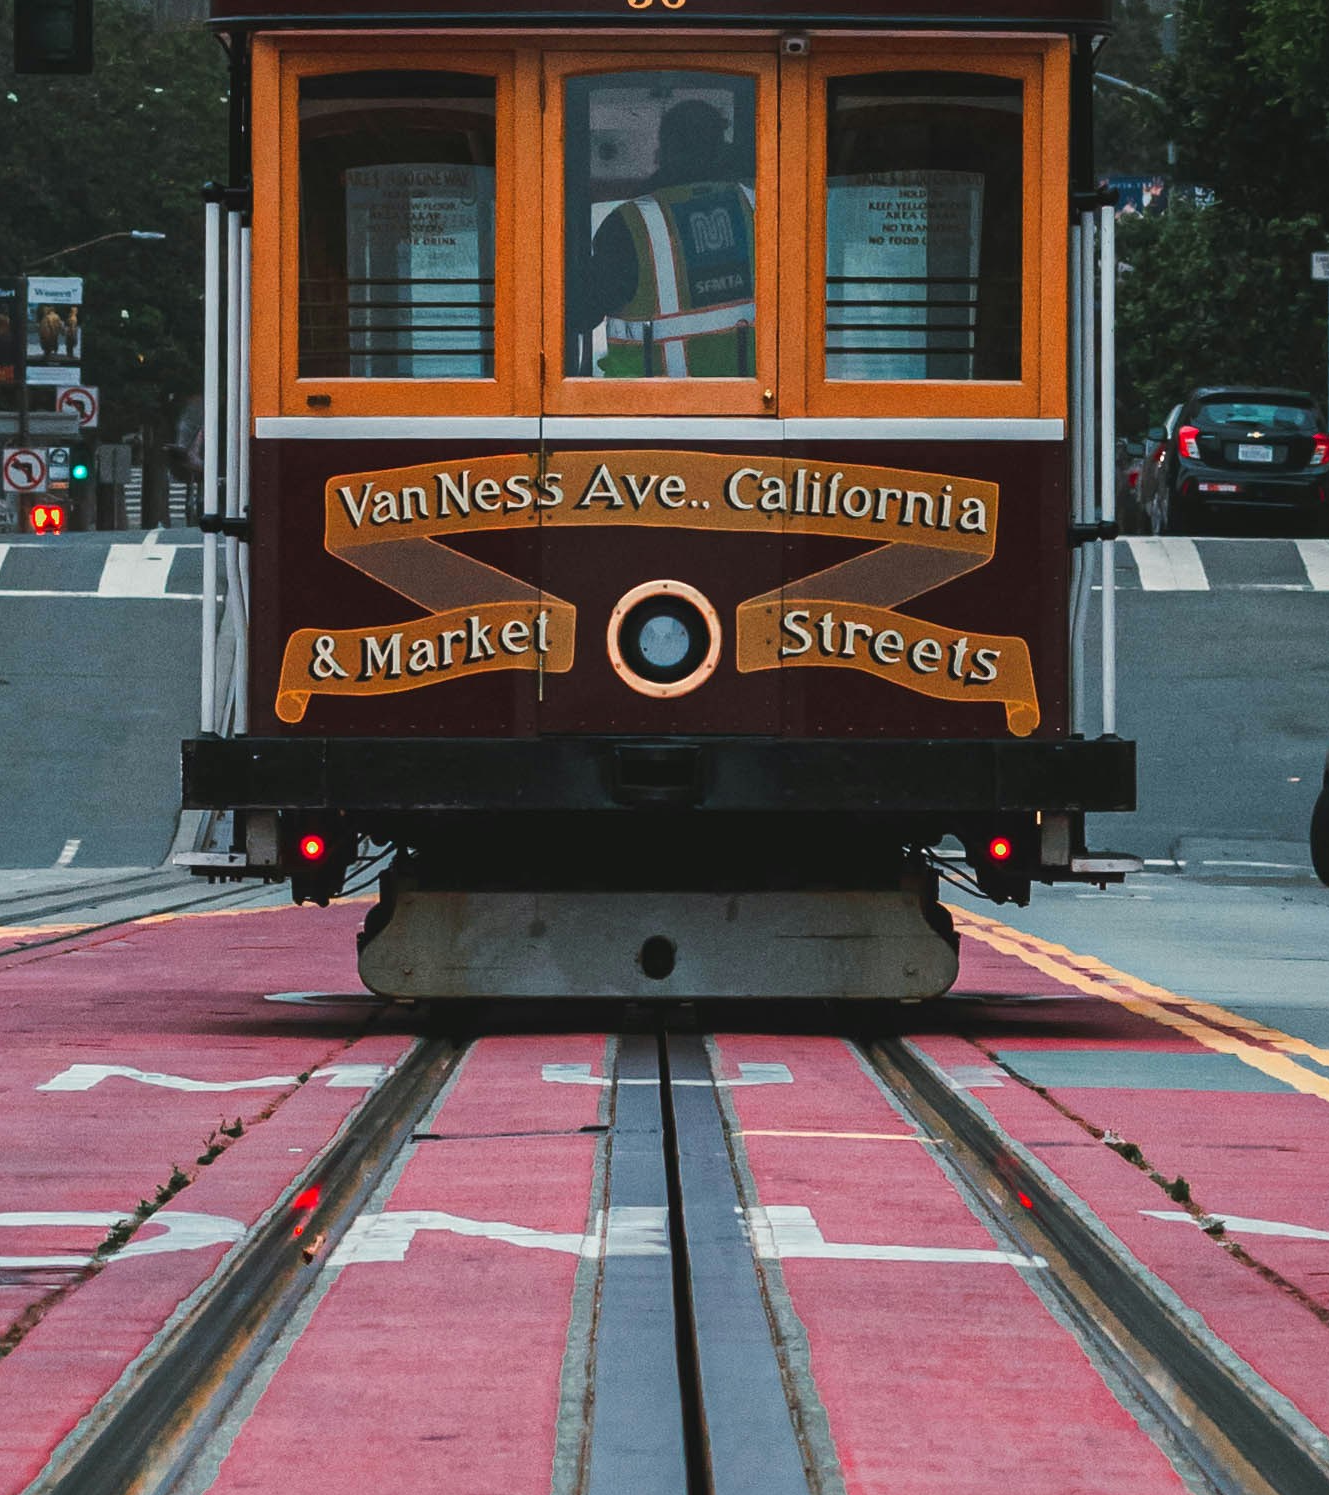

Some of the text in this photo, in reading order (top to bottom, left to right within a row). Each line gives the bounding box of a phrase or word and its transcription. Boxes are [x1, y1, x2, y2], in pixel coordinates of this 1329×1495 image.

[868, 201, 892, 211] KEEP
[882, 224, 897, 233] NO
[339, 482, 430, 529] Van
[436, 470, 563, 516] Ness
[727, 467, 988, 534] California
[312, 610, 552, 680] & Market
[781, 609, 1003, 683] Streets
